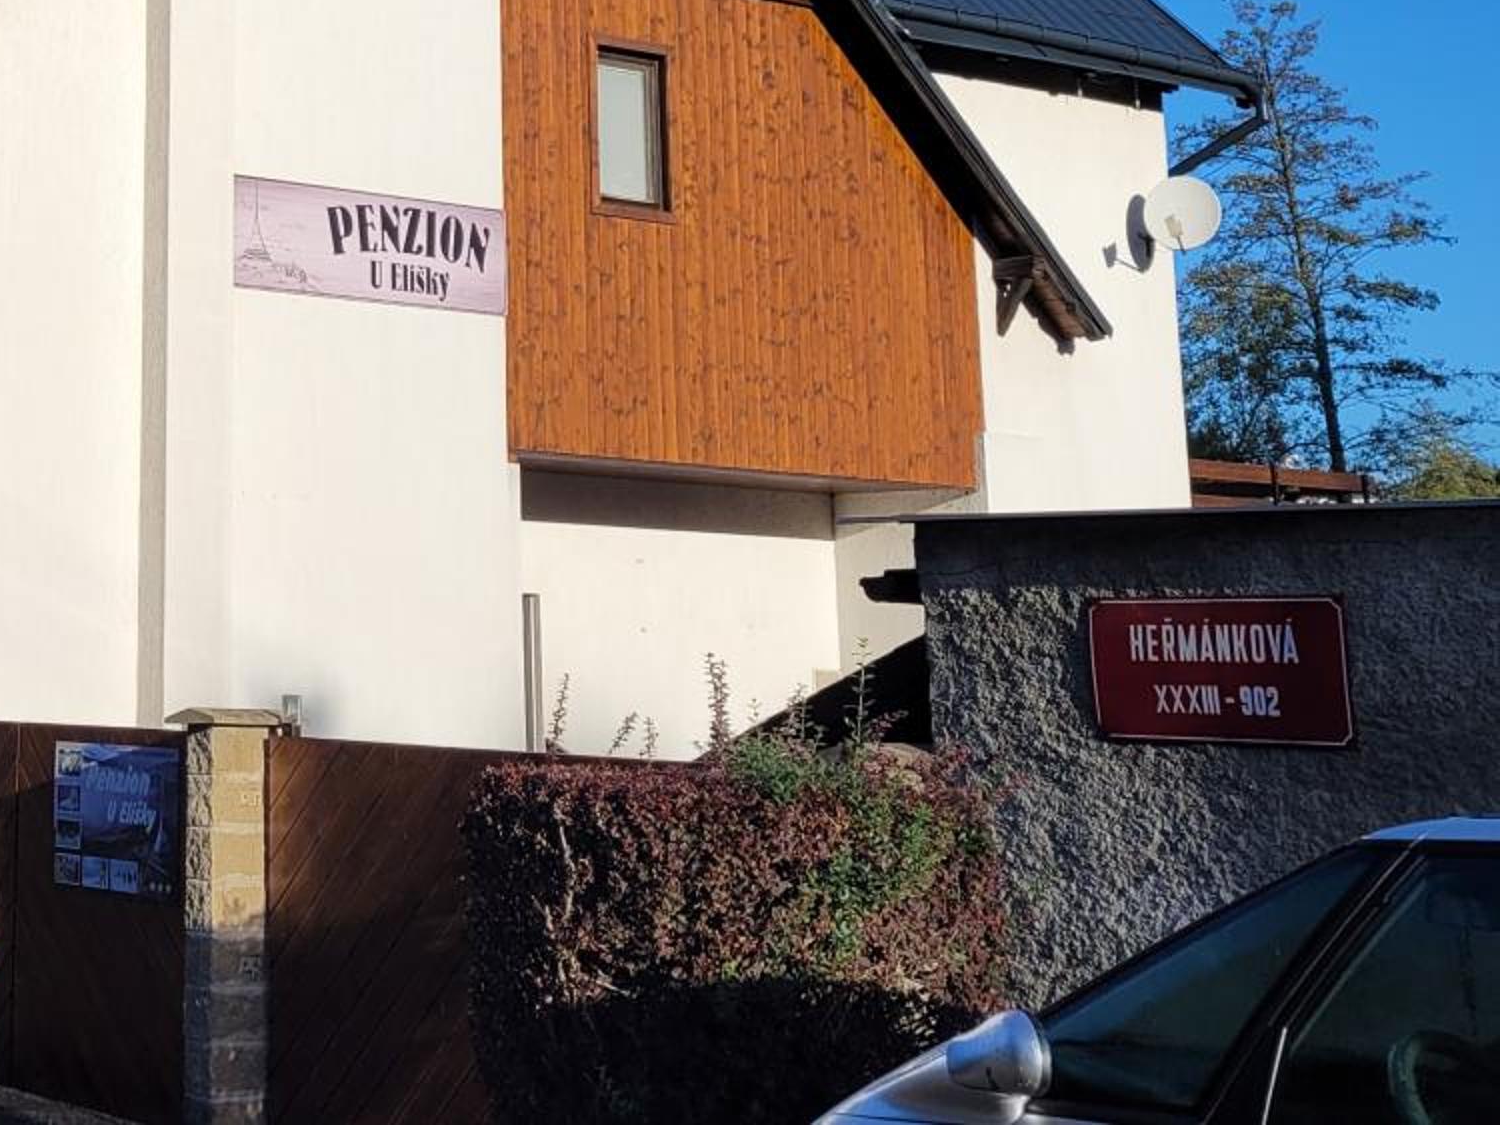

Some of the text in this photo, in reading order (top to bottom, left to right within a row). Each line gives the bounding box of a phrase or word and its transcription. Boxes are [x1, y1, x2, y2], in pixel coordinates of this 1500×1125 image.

[326, 204, 490, 273] PENZION
[370, 260, 449, 301] U Elišky
[1129, 618, 1299, 664] HEŘMÁNKOVÁ
[1239, 685, 1281, 717] 902
[107, 798, 117, 822] U
